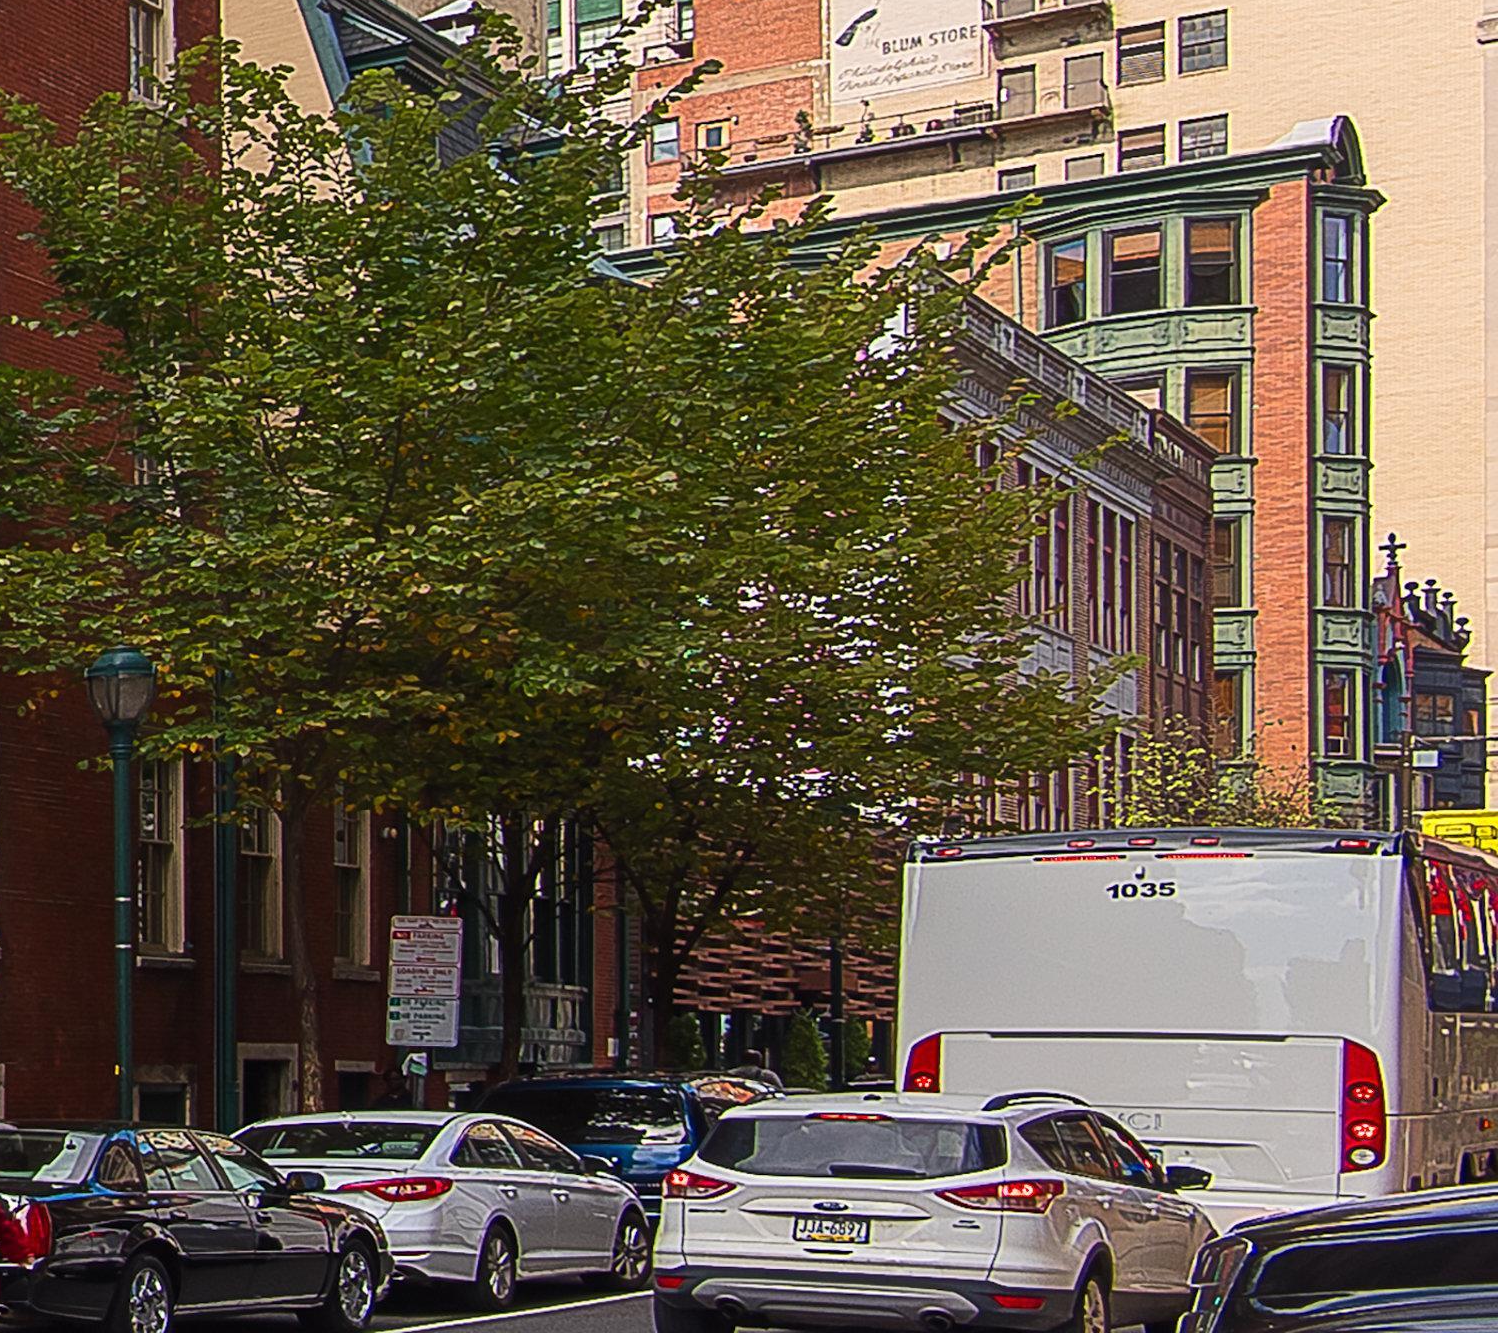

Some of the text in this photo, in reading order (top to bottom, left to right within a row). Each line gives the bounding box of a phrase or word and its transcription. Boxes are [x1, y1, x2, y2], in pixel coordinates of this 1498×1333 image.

[882, 35, 922, 55] BLUM
[928, 24, 978, 45] STORE
[1106, 882, 1176, 899] 1035
[1118, 1112, 1163, 1131] CI
